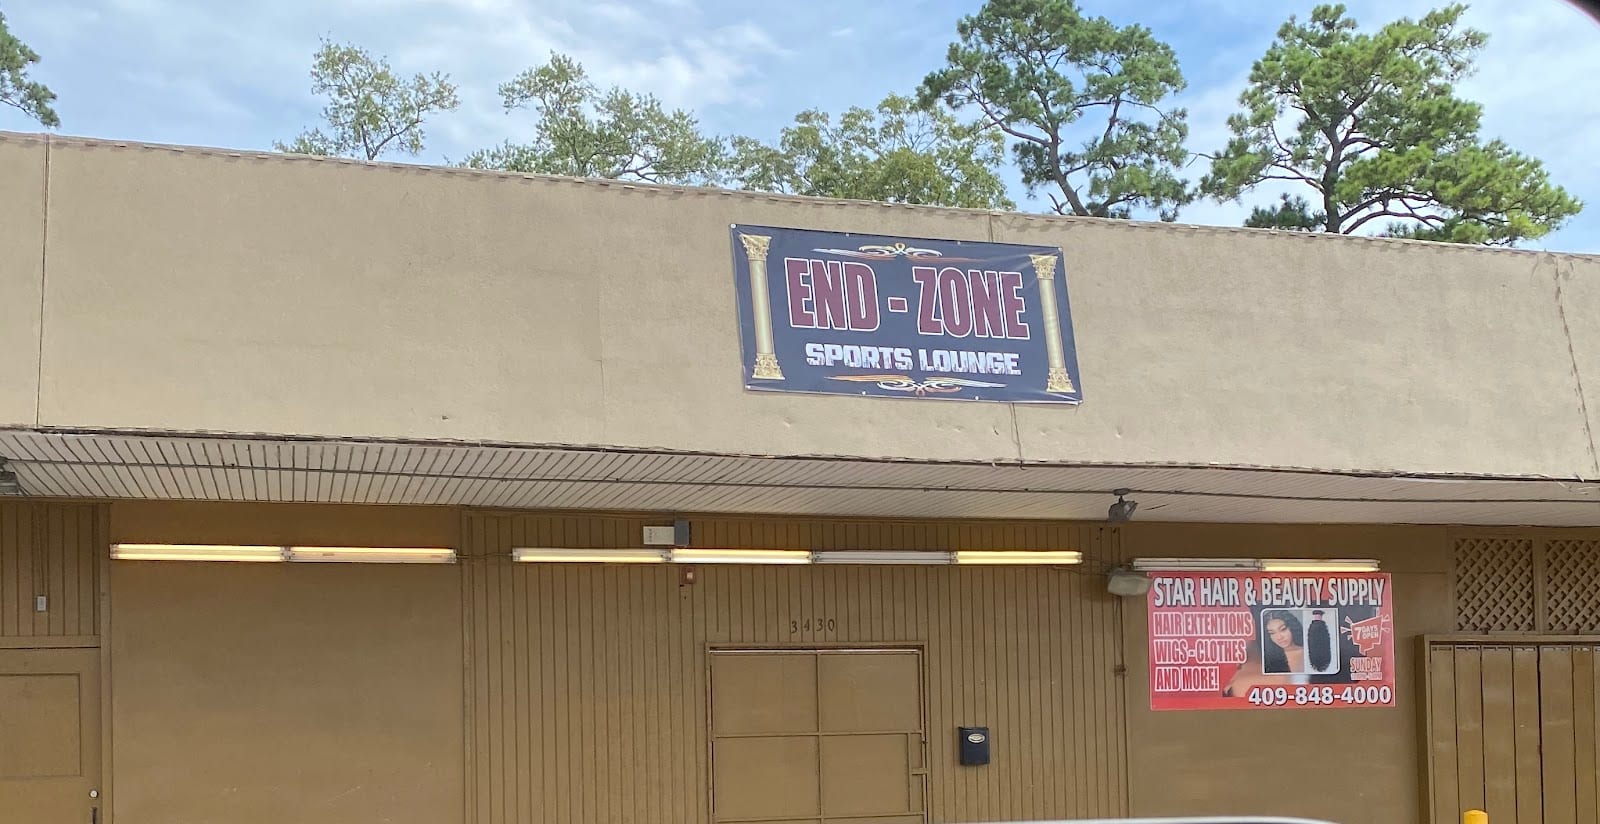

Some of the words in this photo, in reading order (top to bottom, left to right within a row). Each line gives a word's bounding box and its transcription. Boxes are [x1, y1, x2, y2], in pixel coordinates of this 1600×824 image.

[784, 258, 880, 331] END
[912, 267, 1031, 340] ZONE
[805, 343, 913, 371] SPORTS
[918, 348, 1022, 376] LOUNGE
[1153, 577, 1196, 607] STAR
[1200, 577, 1240, 607] HAIR
[1244, 577, 1257, 606] &
[1261, 577, 1324, 607] BEAUTY
[1327, 577, 1385, 607] SUPPLY
[791, 618, 835, 634] 3430
[1153, 612, 1184, 637] HAIR
[1184, 611, 1253, 637] EXTENTIONS
[1354, 626, 1362, 641] 7
[1361, 624, 1379, 634] DAYS
[1362, 632, 1379, 640] OPEN
[1350, 656, 1382, 673] SUNDAY
[1155, 667, 1182, 691] AND
[1181, 666, 1220, 691] MORE!
[1248, 685, 1392, 706] 409-848-4000
